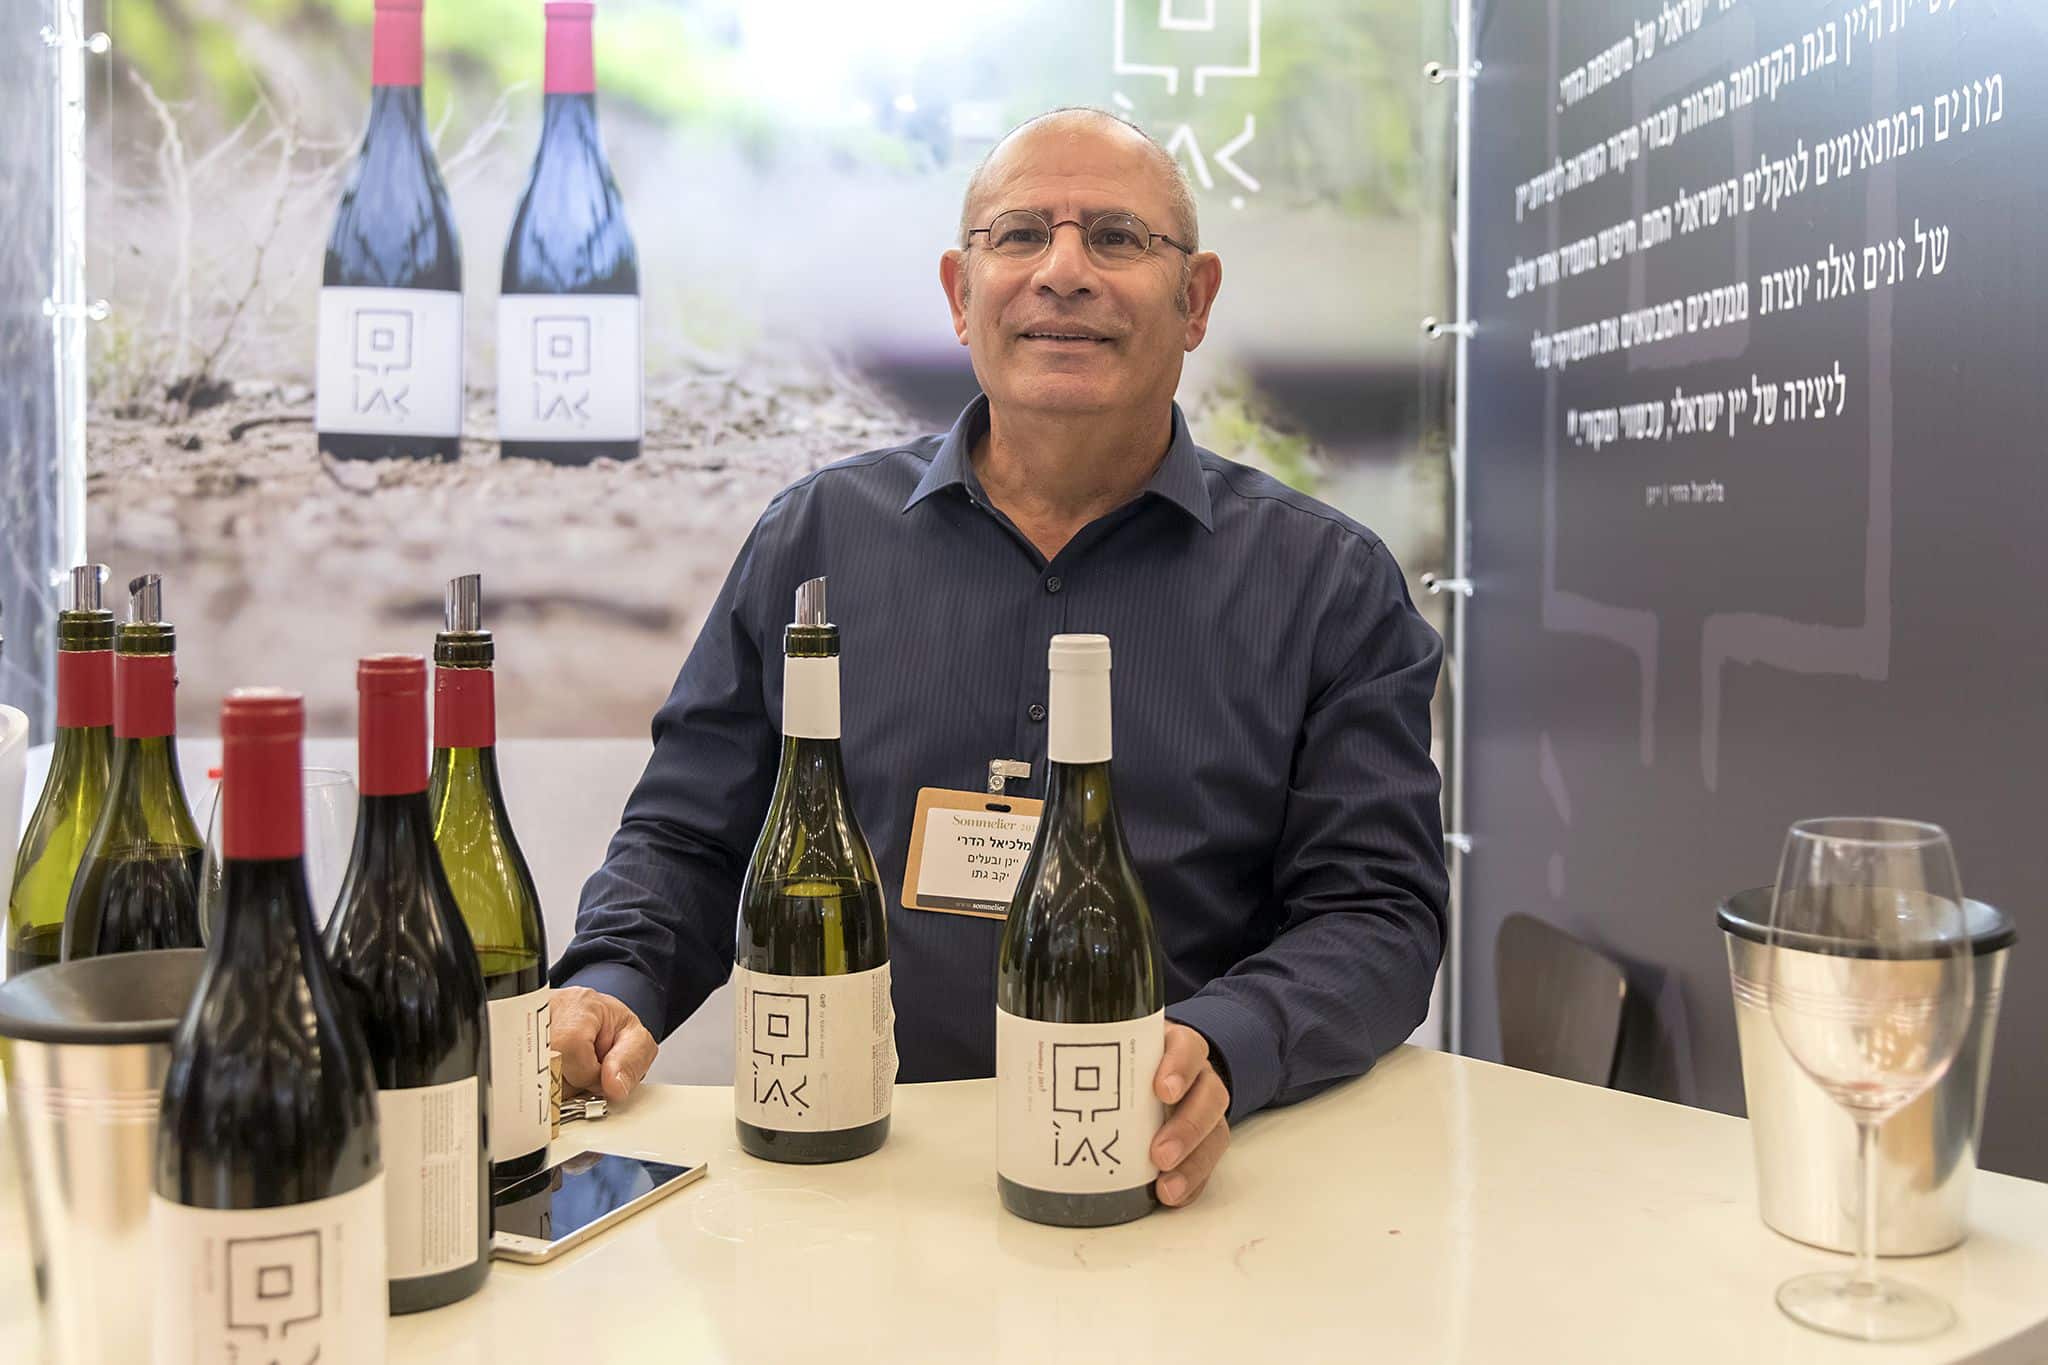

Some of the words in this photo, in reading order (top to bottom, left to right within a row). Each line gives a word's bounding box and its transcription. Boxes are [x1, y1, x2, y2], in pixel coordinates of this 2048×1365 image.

[1634, 18, 1656, 63] של
[1801, 22, 1837, 76] בגת
[1729, 42, 1795, 111] הקדומה
[1641, 104, 1678, 150] עבורי
[1681, 80, 1726, 133] מהווה
[1933, 73, 2004, 142] מזנים
[1815, 104, 1924, 186] המתאימים
[1743, 139, 1809, 212] לאקלים
[1674, 178, 1739, 236] הישראלי
[1816, 243, 1855, 301] אלה
[1863, 237, 1906, 290] זנים
[1914, 218, 1949, 279] של
[1687, 281, 1749, 333] ממסכים
[1760, 263, 1810, 315] יוצרת
[1600, 316, 1619, 354] את
[1620, 299, 1684, 349] המבטאים
[1666, 386, 1724, 441] ישראלי,
[1727, 387, 1748, 437] יין
[1752, 374, 1778, 426] של
[1784, 360, 1847, 421] ליצירה
[952, 814, 1017, 831] Sommelier
[957, 835, 985, 847] הדרי
[989, 836, 1032, 851] מלכיאל
[968, 854, 1002, 866] ובעלים
[971, 869, 989, 880] גתו
[991, 872, 1010, 883] יקב
[1005, 858, 1019, 868] יינן
